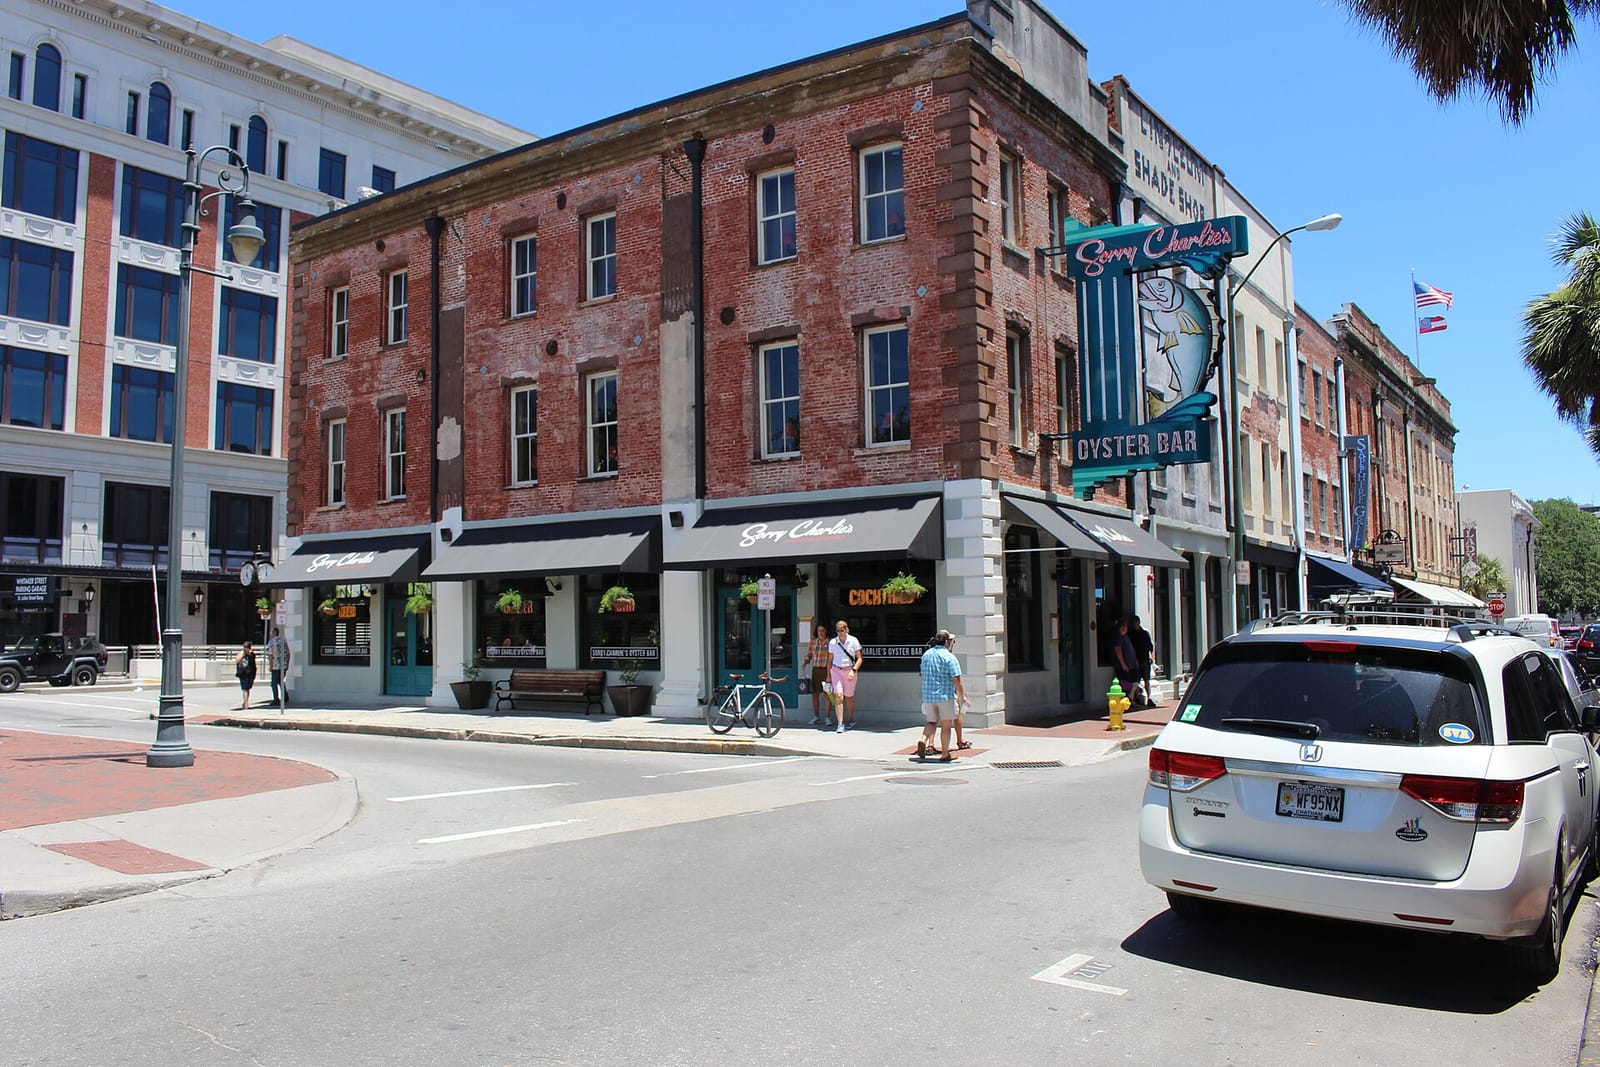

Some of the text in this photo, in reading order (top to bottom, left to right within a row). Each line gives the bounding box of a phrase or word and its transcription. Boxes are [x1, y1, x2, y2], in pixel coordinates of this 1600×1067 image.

[1134, 149, 1176, 206] SHADE
[1075, 221, 1232, 277] Sorry Charlie's
[1077, 430, 1197, 460] OYSTER BAR
[739, 518, 854, 547] Sorry Charlie's
[1465, 529, 1477, 561] LADY
[306, 554, 338, 573] Sorry
[1489, 603, 1505, 611] STOP
[592, 649, 606, 657] SORRY
[629, 649, 645, 657] OYSTER
[646, 649, 656, 657] BAR
[862, 647, 923, 656] HARLIE'S OYSTER BAR
